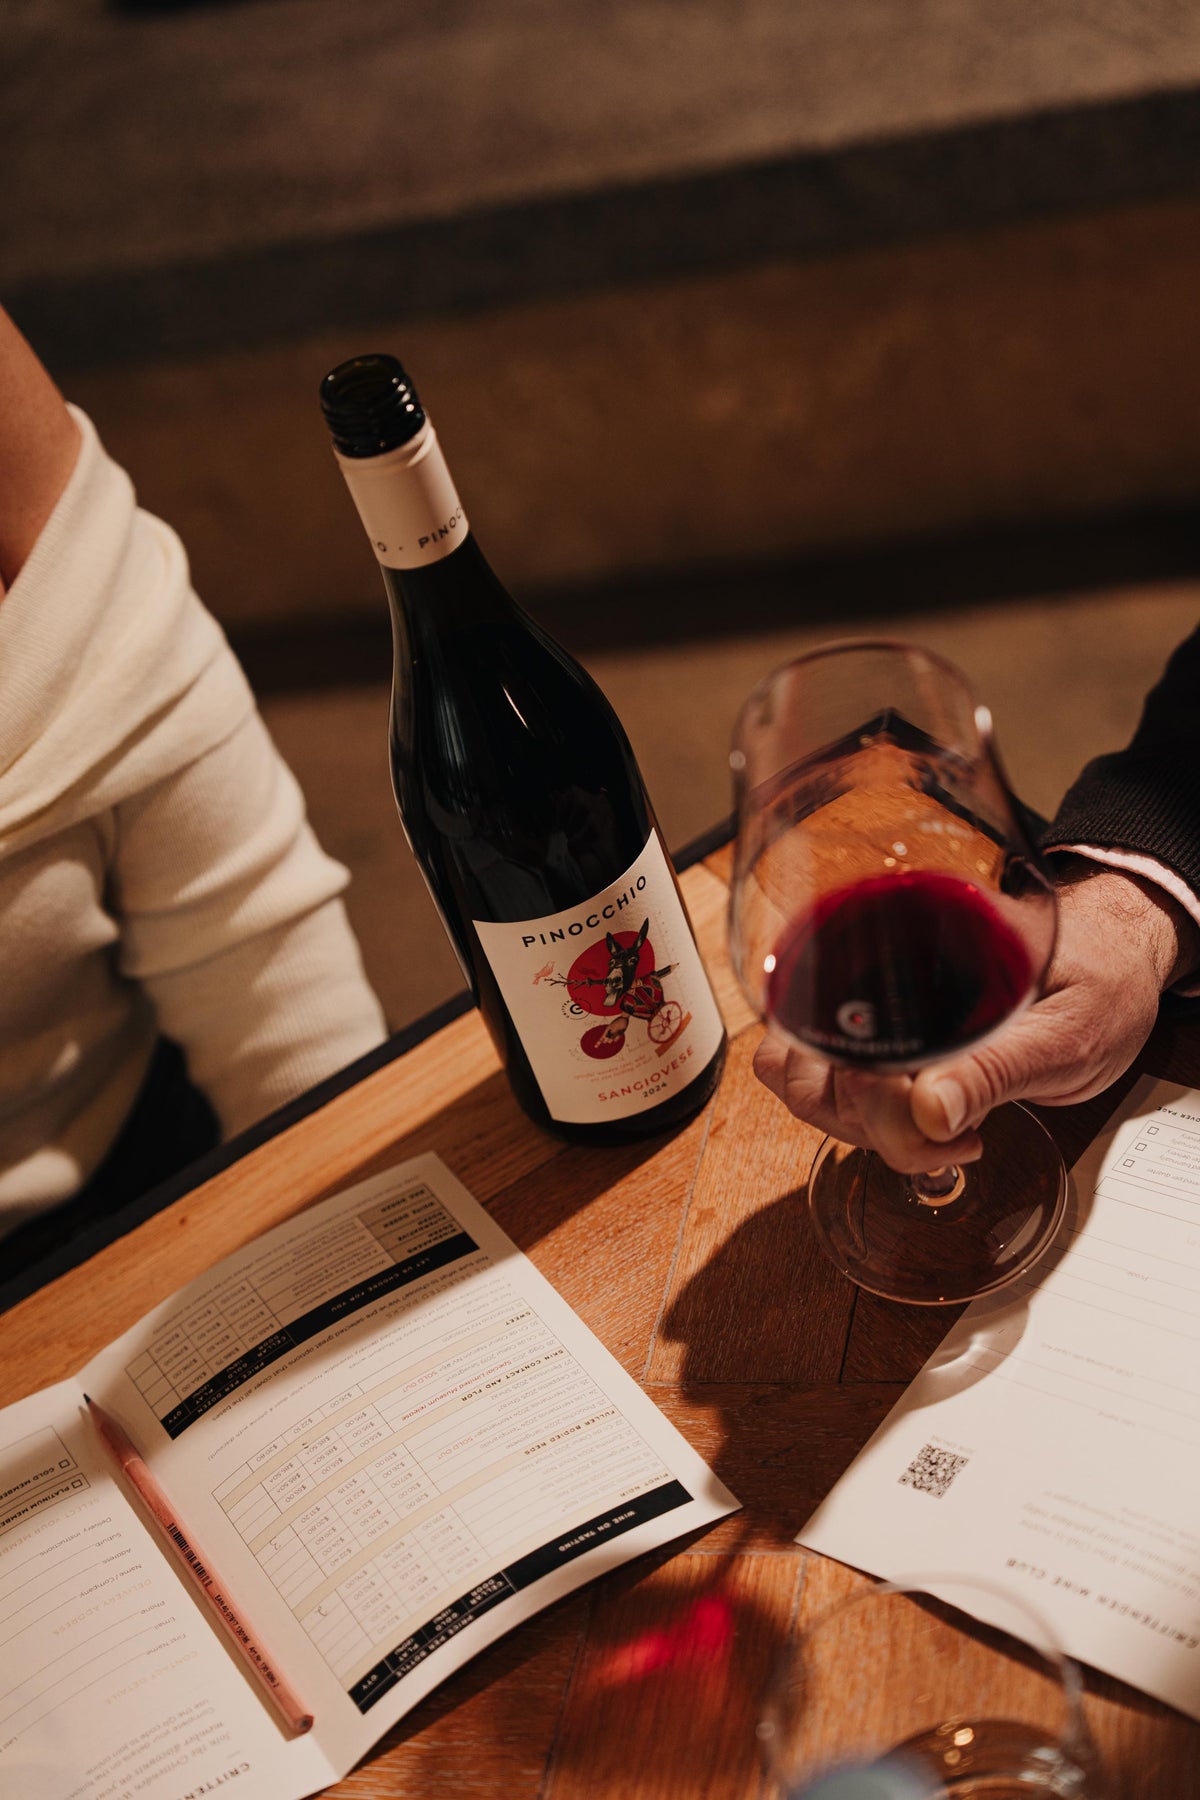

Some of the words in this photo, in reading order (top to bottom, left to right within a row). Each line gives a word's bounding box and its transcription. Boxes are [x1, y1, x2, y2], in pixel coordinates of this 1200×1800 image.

[521, 875, 647, 947] PINOCCHIO
[597, 1045, 695, 1102] SANGIOVESE
[641, 1080, 668, 1098] 2024
[1155, 1105, 1177, 1116] PAGE
[1180, 1112, 1200, 1123] OVER
[421, 1271, 470, 1300] SELECTED
[385, 1298, 418, 1319] PACKS
[503, 1310, 531, 1327] SWEET
[543, 1348, 563, 1361] SKIN
[484, 1358, 512, 1376] Special
[503, 1358, 541, 1380] CONTACT
[416, 1369, 438, 1385] SOLD
[457, 1372, 485, 1390] Limited
[484, 1377, 502, 1390] AND
[401, 1381, 417, 1393] OUT
[460, 1387, 482, 1402] FLOR
[426, 1386, 458, 1408] Museum
[400, 1403, 428, 1422] release
[583, 1408, 615, 1427] FULLER
[358, 1430, 382, 1448] $55.00
[451, 1435, 473, 1451] SOLD
[548, 1424, 581, 1443] BODIED
[436, 1447, 452, 1460] OUT
[523, 1441, 546, 1455] REDS
[32, 1466, 54, 1481] GOLD
[320, 1456, 343, 1475] $55.00
[643, 1471, 668, 1487] PINOT
[29, 1485, 69, 1509] PLATINUM
[284, 1484, 307, 1503] $55.00
[619, 1484, 640, 1498] NOIR
[62, 1496, 99, 1519] SELECT
[611, 1509, 635, 1524] WINE
[33, 1516, 61, 1535] YOUR
[82, 1515, 111, 1534] Delivery
[596, 1521, 610, 1532] ON
[557, 1529, 595, 1552] TASTING
[118, 1562, 141, 1577] Name
[1006, 1558, 1047, 1581] CLUB
[102, 1577, 152, 1608] DELIVERY
[468, 1579, 505, 1606] CELLAR
[469, 1577, 495, 1597] DOOR
[51, 1605, 101, 1637] ADDRESS
[433, 1611, 459, 1632] GOLD
[446, 1613, 474, 1635] PRICE
[396, 1642, 420, 1662] PLAT
[427, 1634, 446, 1651] PER
[149, 1649, 198, 1680] CONTACT
[394, 1649, 428, 1678] BOTTLE
